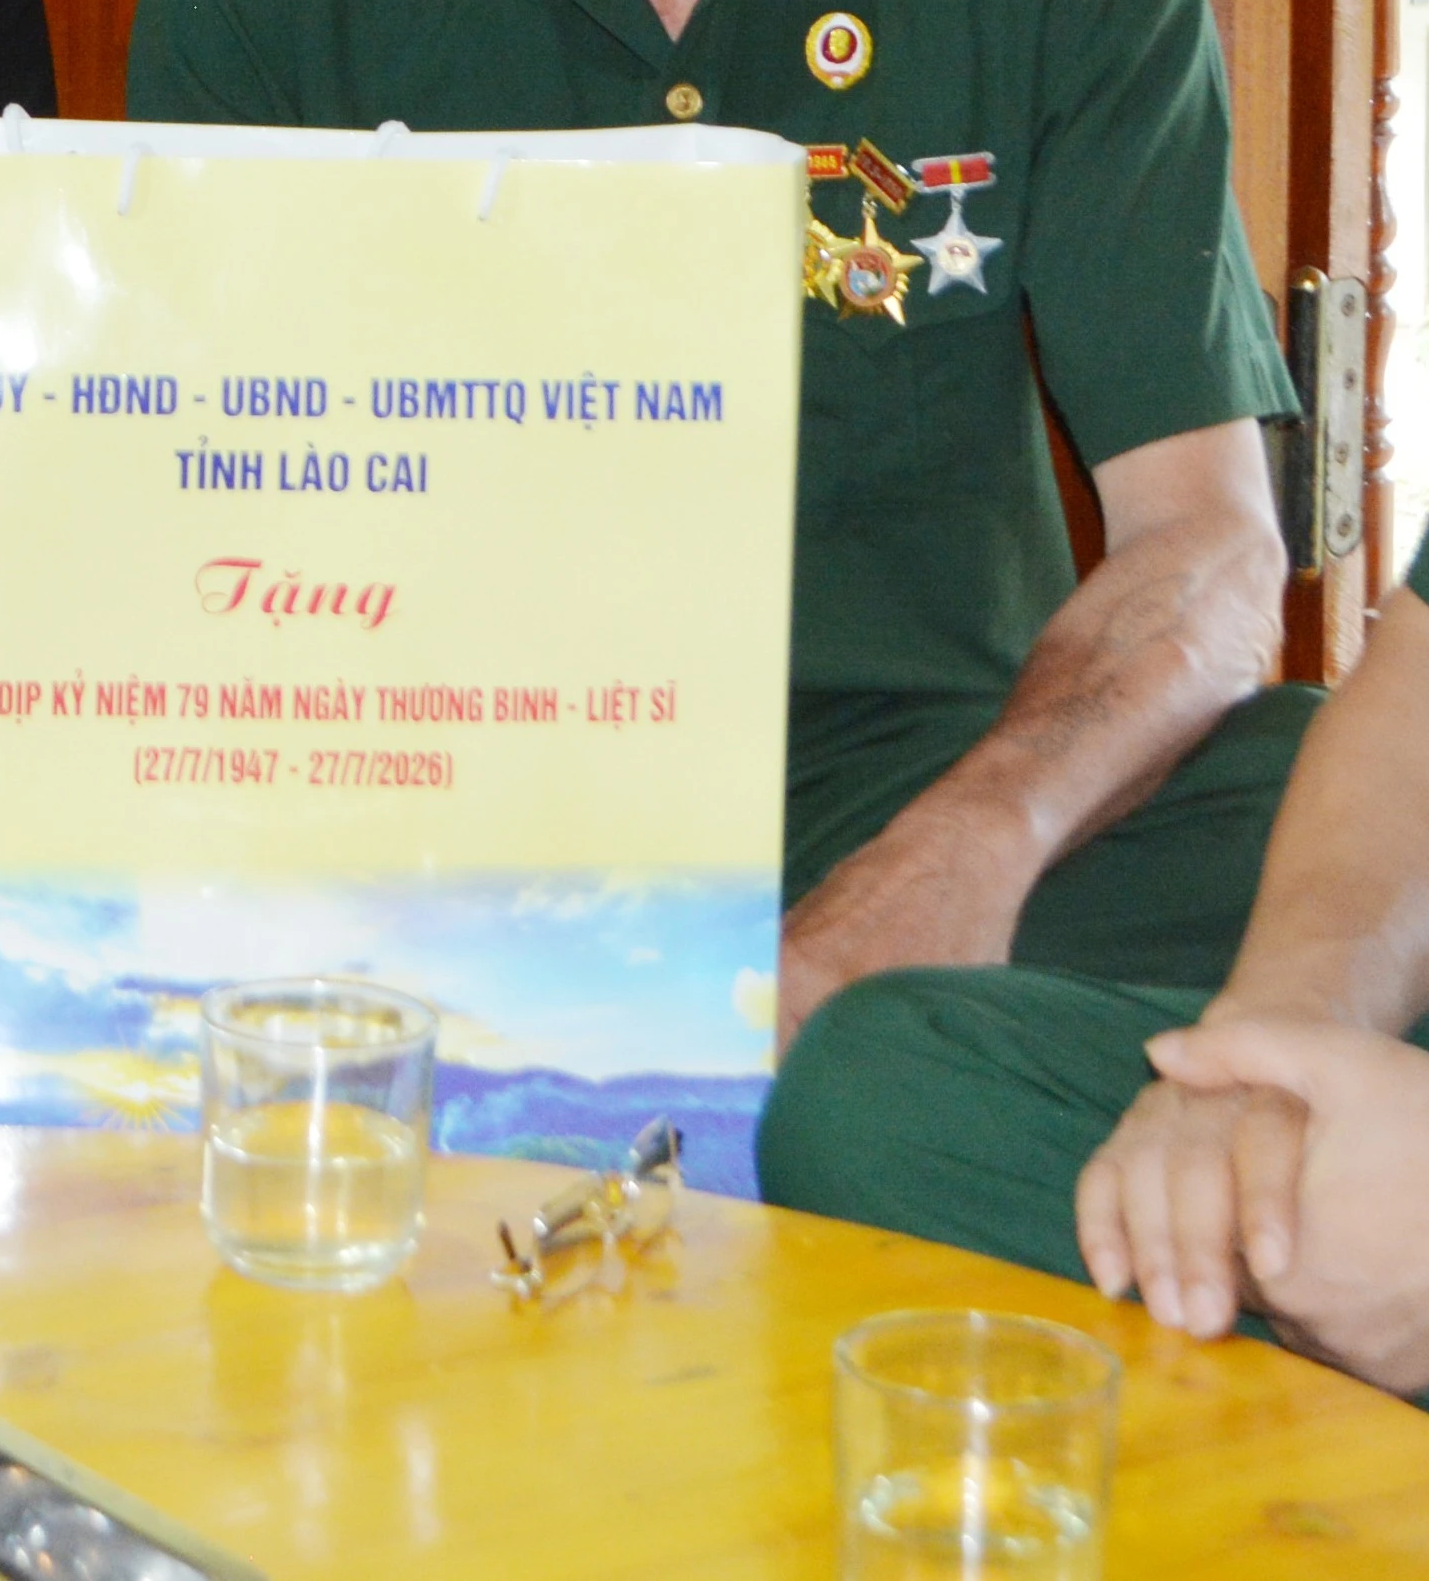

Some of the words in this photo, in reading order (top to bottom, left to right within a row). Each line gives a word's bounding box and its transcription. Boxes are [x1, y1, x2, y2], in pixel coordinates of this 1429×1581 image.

[70, 374, 179, 415] HĐND
[221, 375, 328, 417] UBND
[371, 377, 527, 425] UBMTTQ
[541, 370, 621, 431] VIỆT
[635, 380, 723, 422] NAM
[175, 434, 263, 491] TỈNH
[279, 441, 350, 492] LÀO
[366, 451, 428, 494] CAI
[194, 555, 398, 630] Tặng
[51, 666, 87, 717] KỶ
[95, 672, 168, 726] NIỆM
[176, 682, 210, 719] 79
[218, 675, 283, 721] NĂM
[293, 676, 367, 723] NGÀY
[376, 682, 485, 724] THƯƠNG
[492, 685, 559, 723] BINH
[587, 679, 641, 731] LIỆT
[649, 678, 678, 723] SĨ
[132, 746, 280, 786] (27/7/1947
[308, 749, 455, 789] 27/7/2026)
